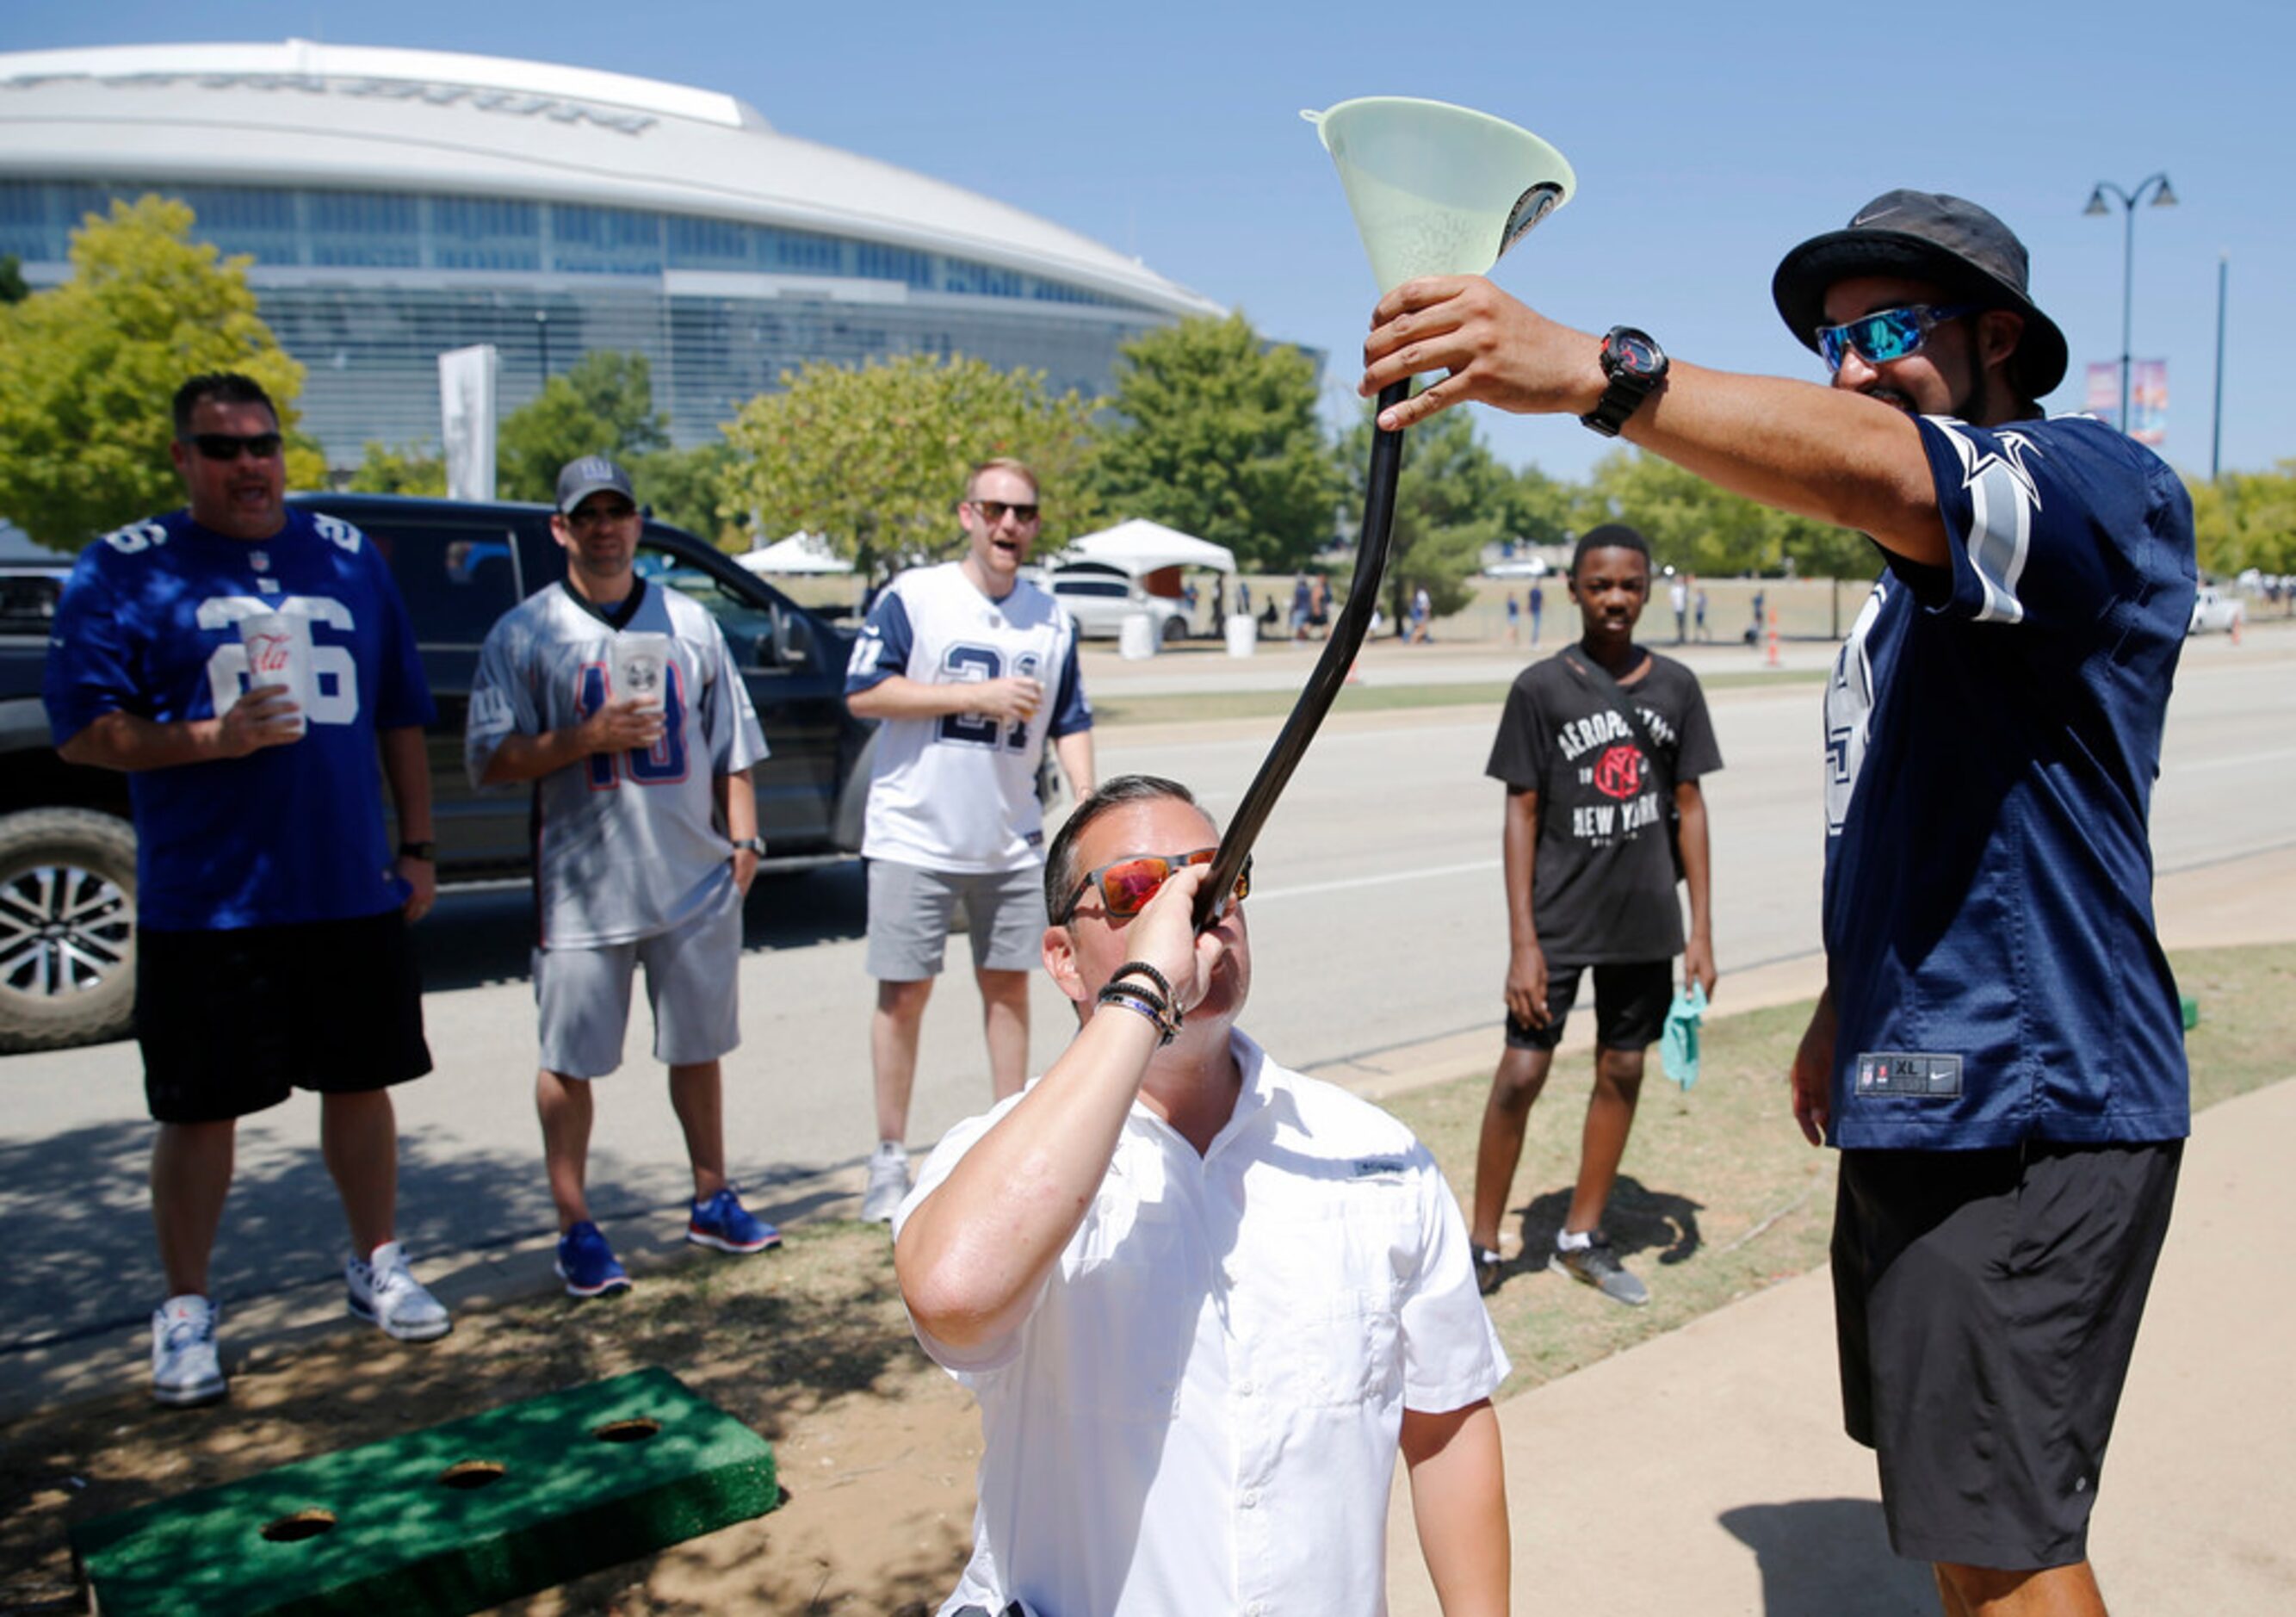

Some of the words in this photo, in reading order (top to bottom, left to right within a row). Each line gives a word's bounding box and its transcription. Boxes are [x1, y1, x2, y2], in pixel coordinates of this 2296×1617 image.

[196, 596, 360, 725] 26
[932, 639, 1043, 756] 21
[575, 658, 687, 791] 10
[1573, 805, 1615, 838] NEW
[1896, 1060, 1917, 1075] XL
